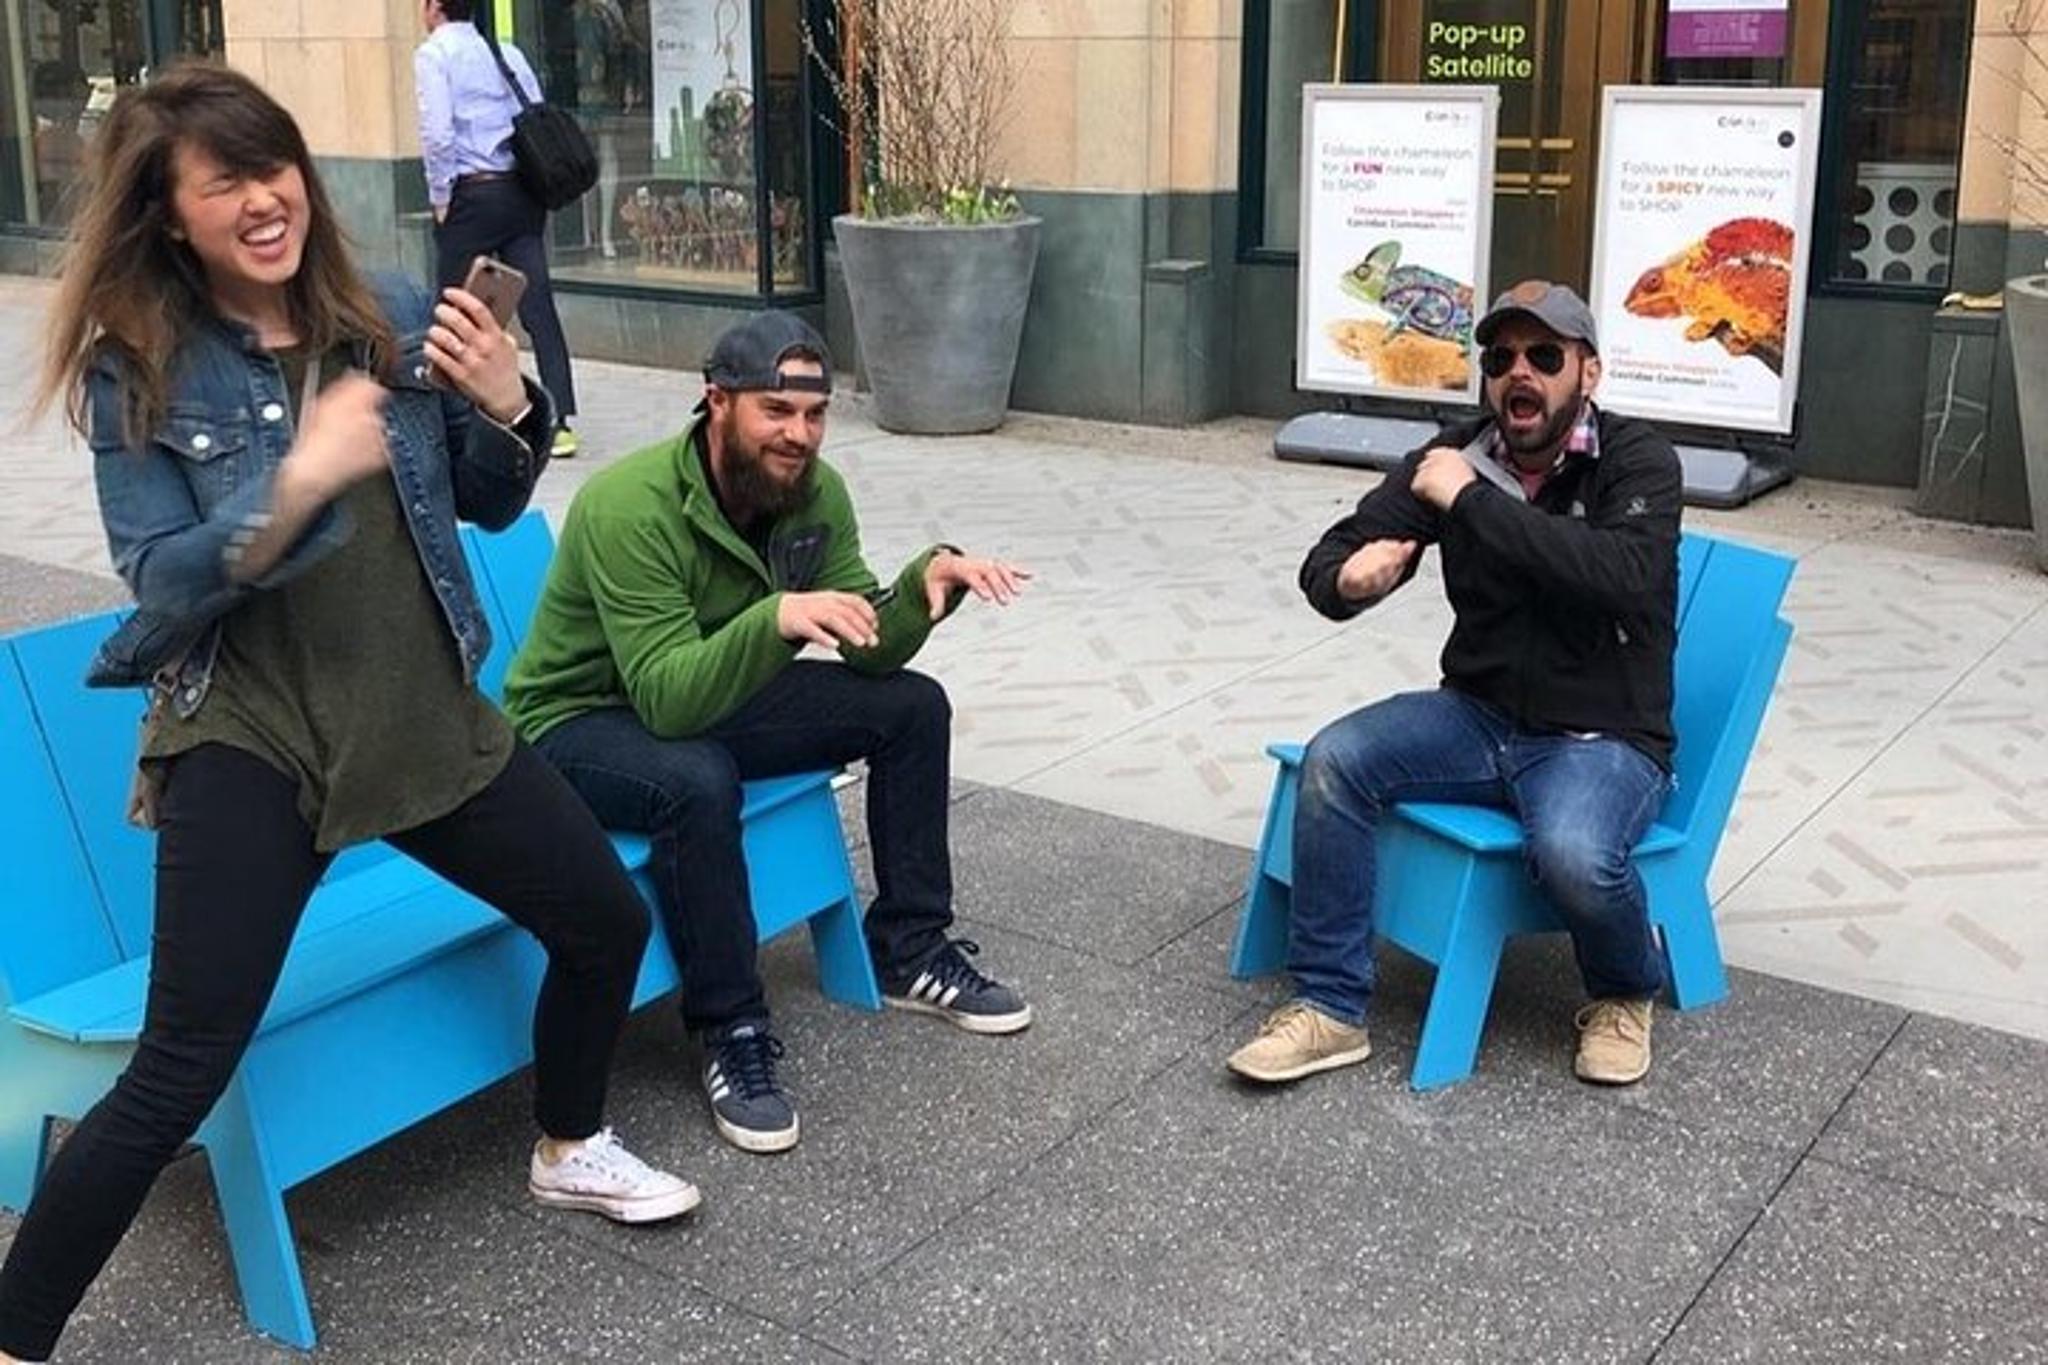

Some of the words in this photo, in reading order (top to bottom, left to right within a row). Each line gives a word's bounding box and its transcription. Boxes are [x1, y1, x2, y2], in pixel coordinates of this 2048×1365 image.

[1429, 22, 1526, 51] Pop-up
[1428, 53, 1532, 77] Satellite
[1322, 143, 1364, 157] Follow
[1368, 144, 1391, 157] the
[1394, 145, 1473, 159] chameleon
[1322, 161, 1339, 174] for
[1353, 161, 1384, 174] FUN
[1386, 165, 1414, 176] new
[1419, 166, 1447, 180] way
[1621, 161, 1668, 176] Follow
[1674, 162, 1699, 176] the
[1703, 163, 1791, 179] chameleon
[1322, 179, 1334, 190] to
[1338, 179, 1376, 192] SHOP
[1621, 180, 1640, 192] for
[1655, 181, 1704, 195] SPICY
[1707, 185, 1740, 197] new
[1745, 187, 1775, 202] way
[1619, 199, 1635, 210] to
[1638, 199, 1683, 212] SHOP
